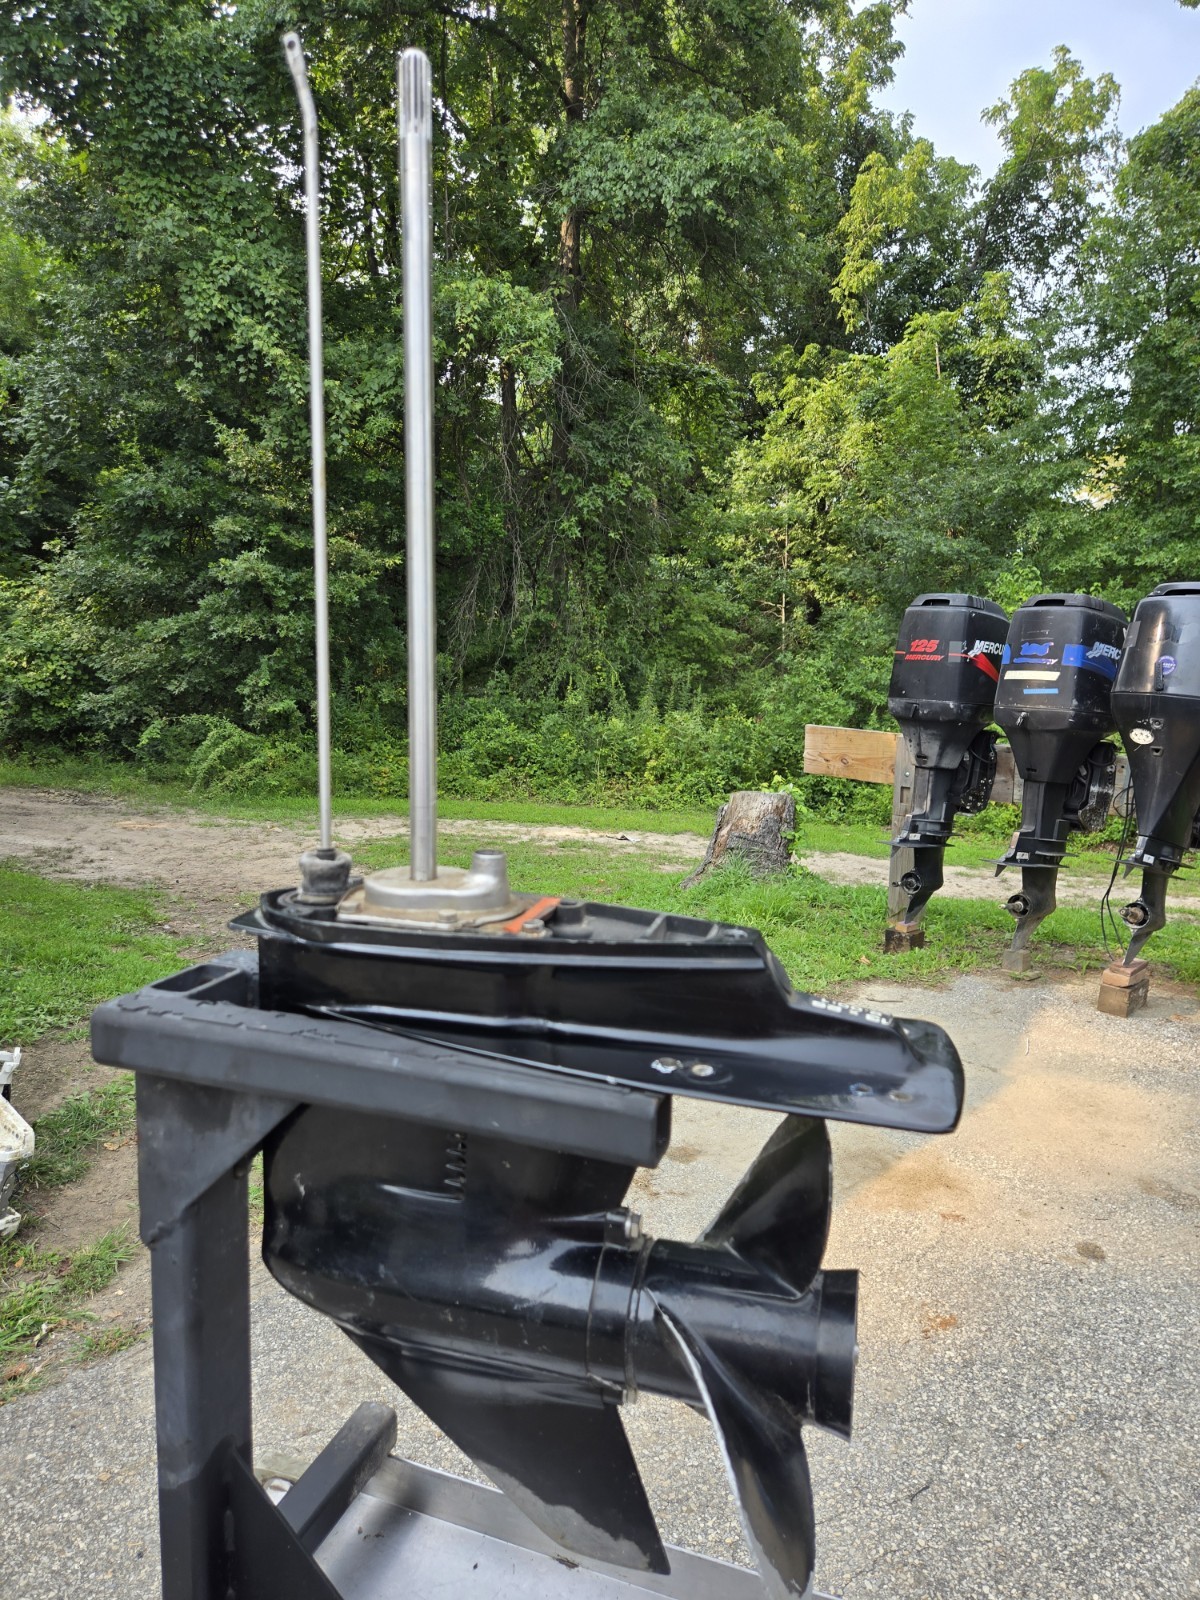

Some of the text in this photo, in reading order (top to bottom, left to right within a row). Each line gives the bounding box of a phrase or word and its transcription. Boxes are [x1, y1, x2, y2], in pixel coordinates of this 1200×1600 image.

[910, 640, 939, 653] 125
[968, 640, 1005, 657] MERCU
[1086, 641, 1121, 660] MERC
